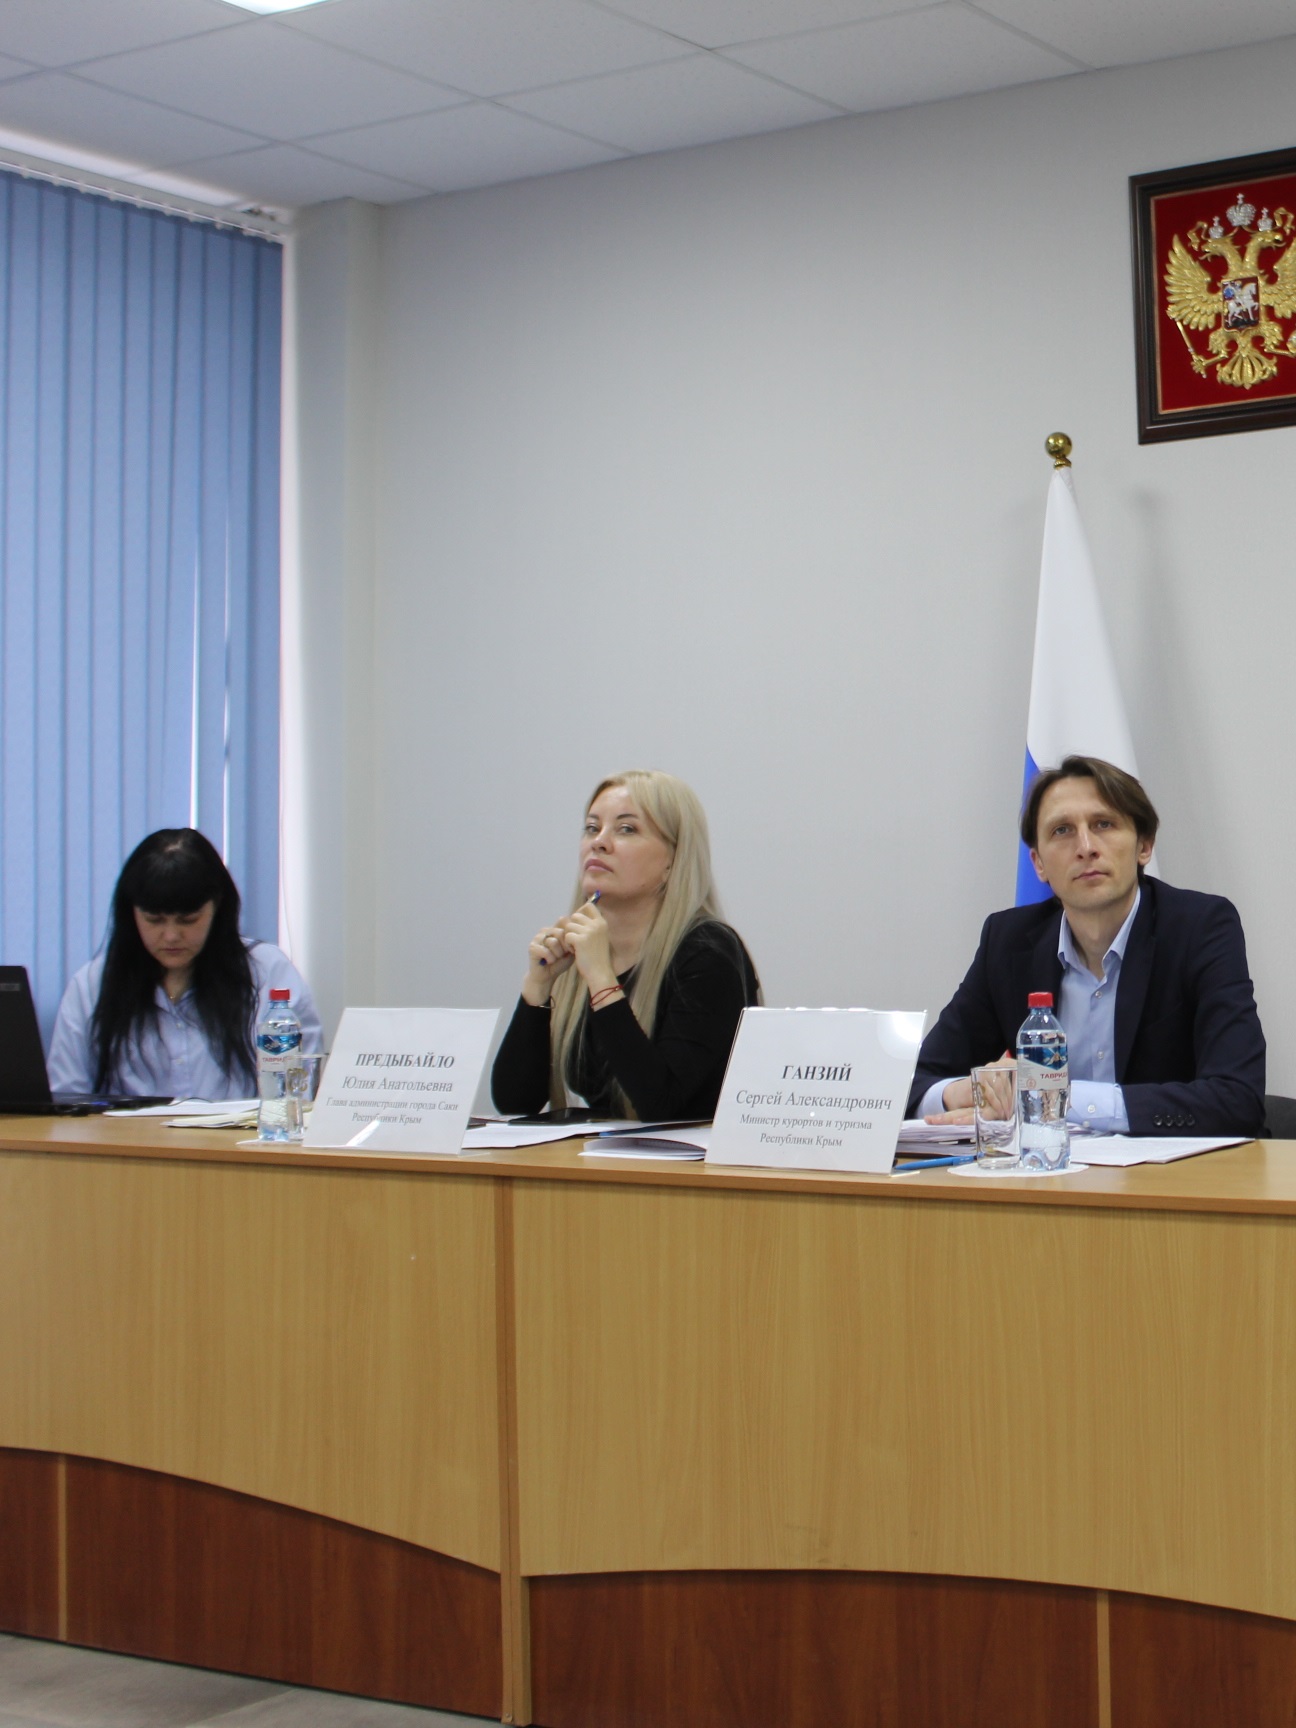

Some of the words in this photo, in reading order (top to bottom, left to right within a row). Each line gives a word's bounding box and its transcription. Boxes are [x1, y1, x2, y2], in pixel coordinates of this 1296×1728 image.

[355, 1052, 455, 1069] ПРЕДЫБАЙЛО
[781, 1062, 853, 1082] ГАНЗИЙ
[342, 1076, 375, 1090] Юлия
[377, 1077, 453, 1092] Анатольевна
[326, 1097, 347, 1107] Глава
[348, 1099, 408, 1110] администрации
[409, 1101, 436, 1111] города
[438, 1101, 459, 1111] Саки
[736, 1089, 781, 1108] Сергей
[785, 1091, 892, 1112] Александрович
[399, 1114, 422, 1125] Крым
[740, 1113, 781, 1127] Министр
[782, 1117, 824, 1130] курортов
[825, 1119, 832, 1127] и
[834, 1119, 872, 1130] туризма
[759, 1132, 814, 1146] Республики
[815, 1135, 843, 1147] Крым
